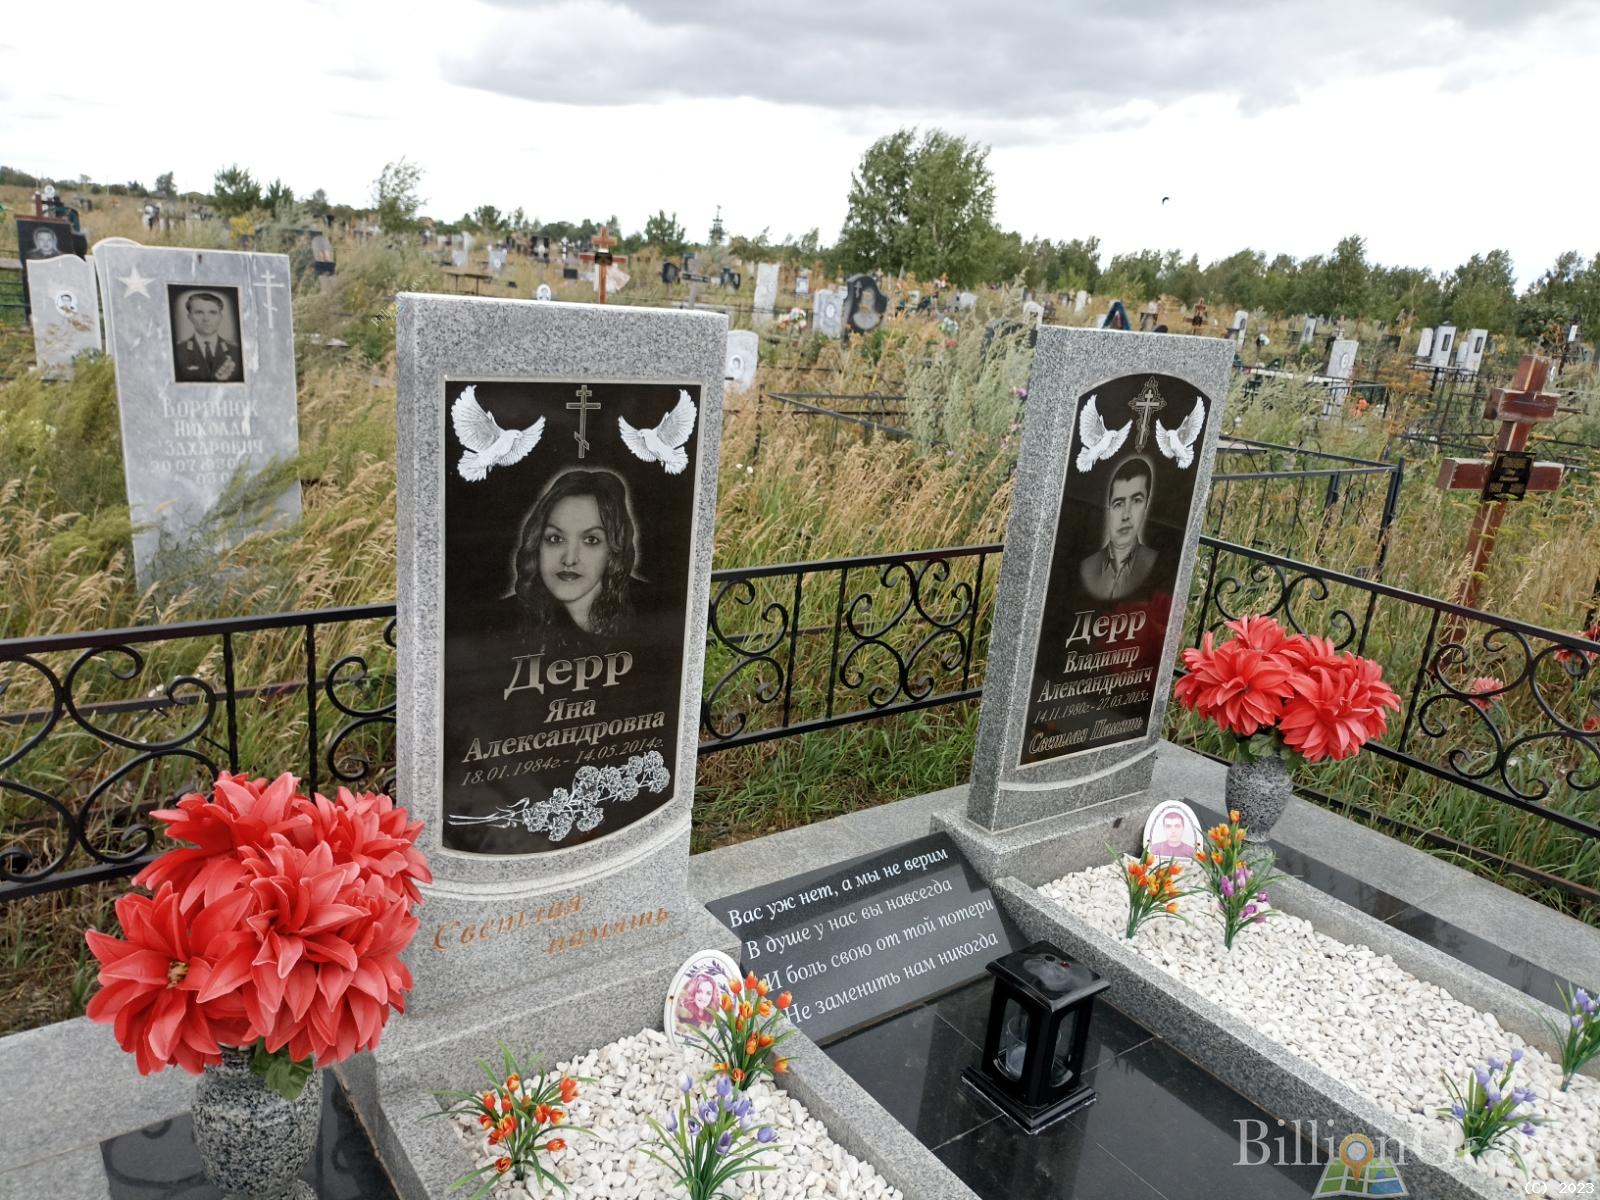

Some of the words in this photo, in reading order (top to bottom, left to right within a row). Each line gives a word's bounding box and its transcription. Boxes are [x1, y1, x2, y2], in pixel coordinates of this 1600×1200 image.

[1065, 610, 1147, 648] Дерр
[504, 650, 633, 700] Дерр
[1037, 667, 1153, 703] Александрович
[1063, 646, 1140, 674] Владимир
[543, 698, 596, 723] Яна
[461, 711, 665, 763] Александровна
[727, 906, 763, 928] Вас
[766, 895, 796, 920] уж
[798, 883, 840, 908] нет,
[841, 877, 853, 893] а
[854, 866, 880, 887] мы
[882, 861, 902, 879] не
[904, 848, 949, 873] верим
[745, 940, 761, 960] В
[765, 925, 812, 956] душе
[813, 922, 826, 942] у
[828, 911, 858, 932] нас
[861, 904, 883, 921] вы
[886, 877, 953, 913] навсегда
[764, 969, 783, 993] И
[786, 960, 827, 984] боль
[830, 940, 872, 966] свою
[875, 933, 901, 952] от
[902, 915, 936, 940] той
[938, 897, 995, 928] потери
[783, 1003, 813, 1026] Не
[815, 972, 901, 1015] заменить
[902, 957, 937, 980] нам
[937, 930, 999, 967] никогда
